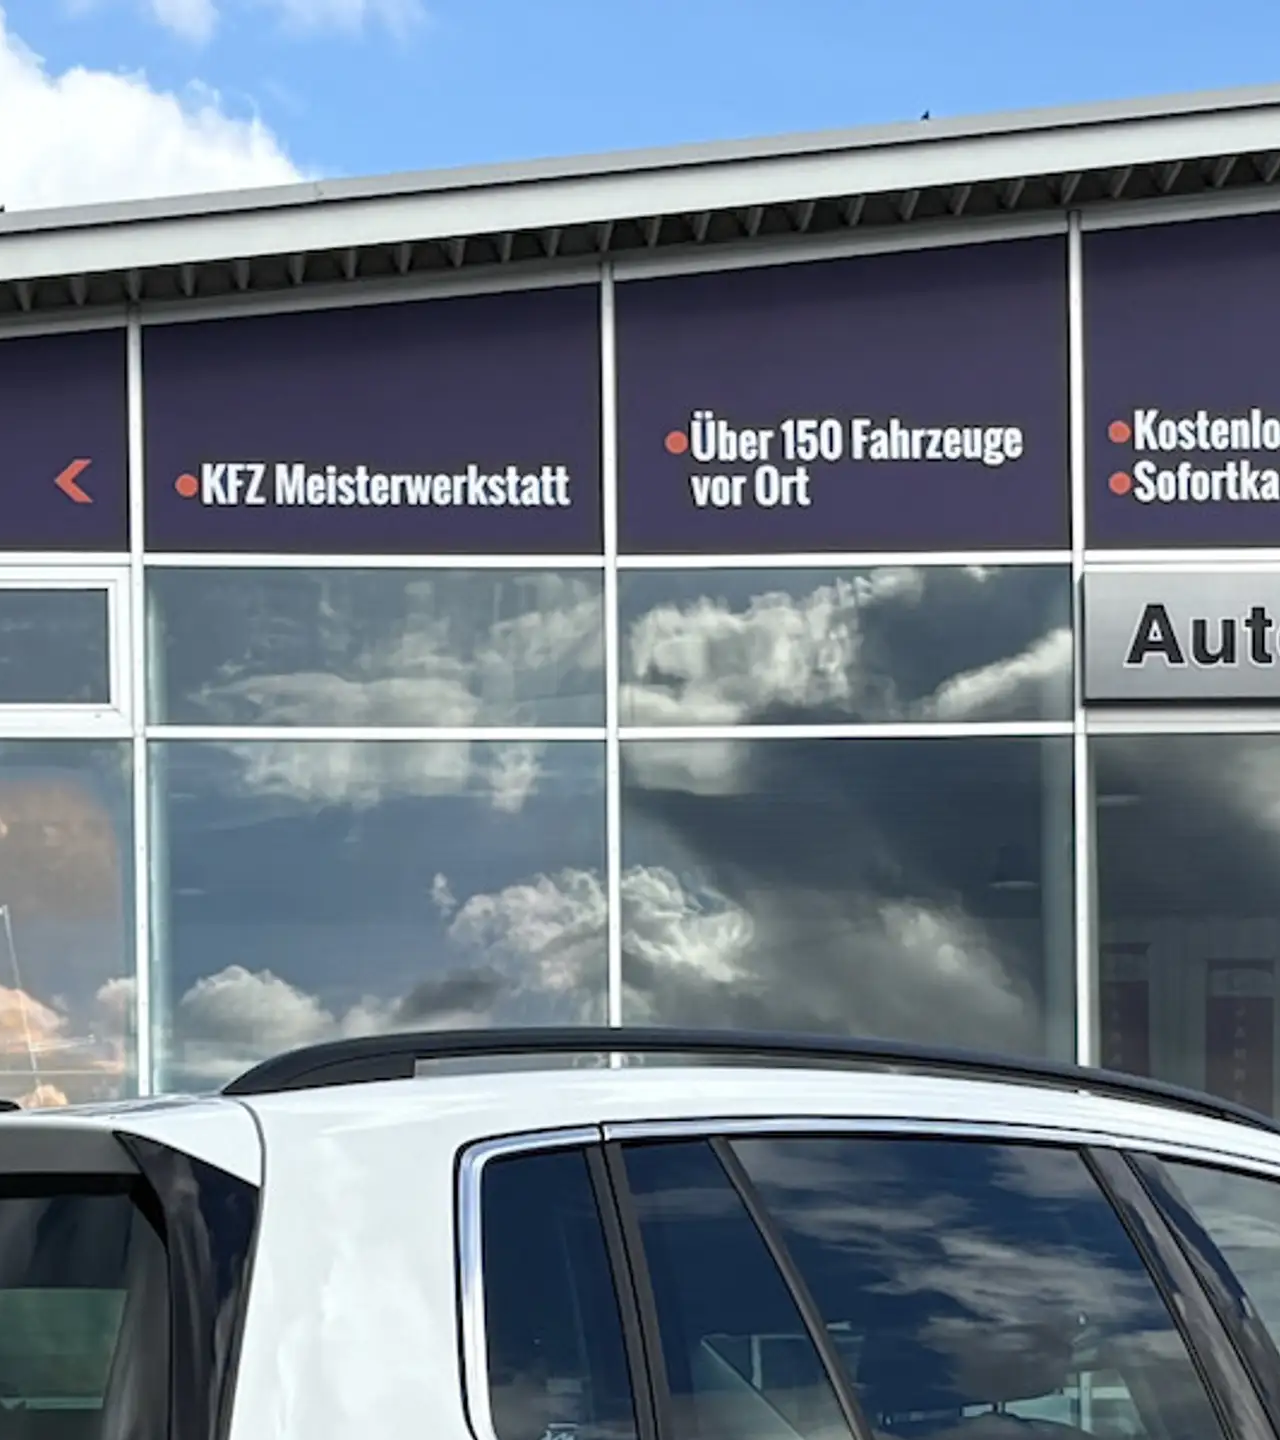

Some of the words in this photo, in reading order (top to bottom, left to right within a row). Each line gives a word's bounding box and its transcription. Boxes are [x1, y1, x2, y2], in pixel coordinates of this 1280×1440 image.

[690, 410, 775, 462] Über
[780, 418, 843, 461] 150
[851, 418, 1023, 466] Fahrzeuge
[202, 463, 266, 505] KFZ
[275, 463, 571, 506] Meisterwerkstatt
[691, 475, 748, 507] vor
[755, 464, 811, 507] Ort
